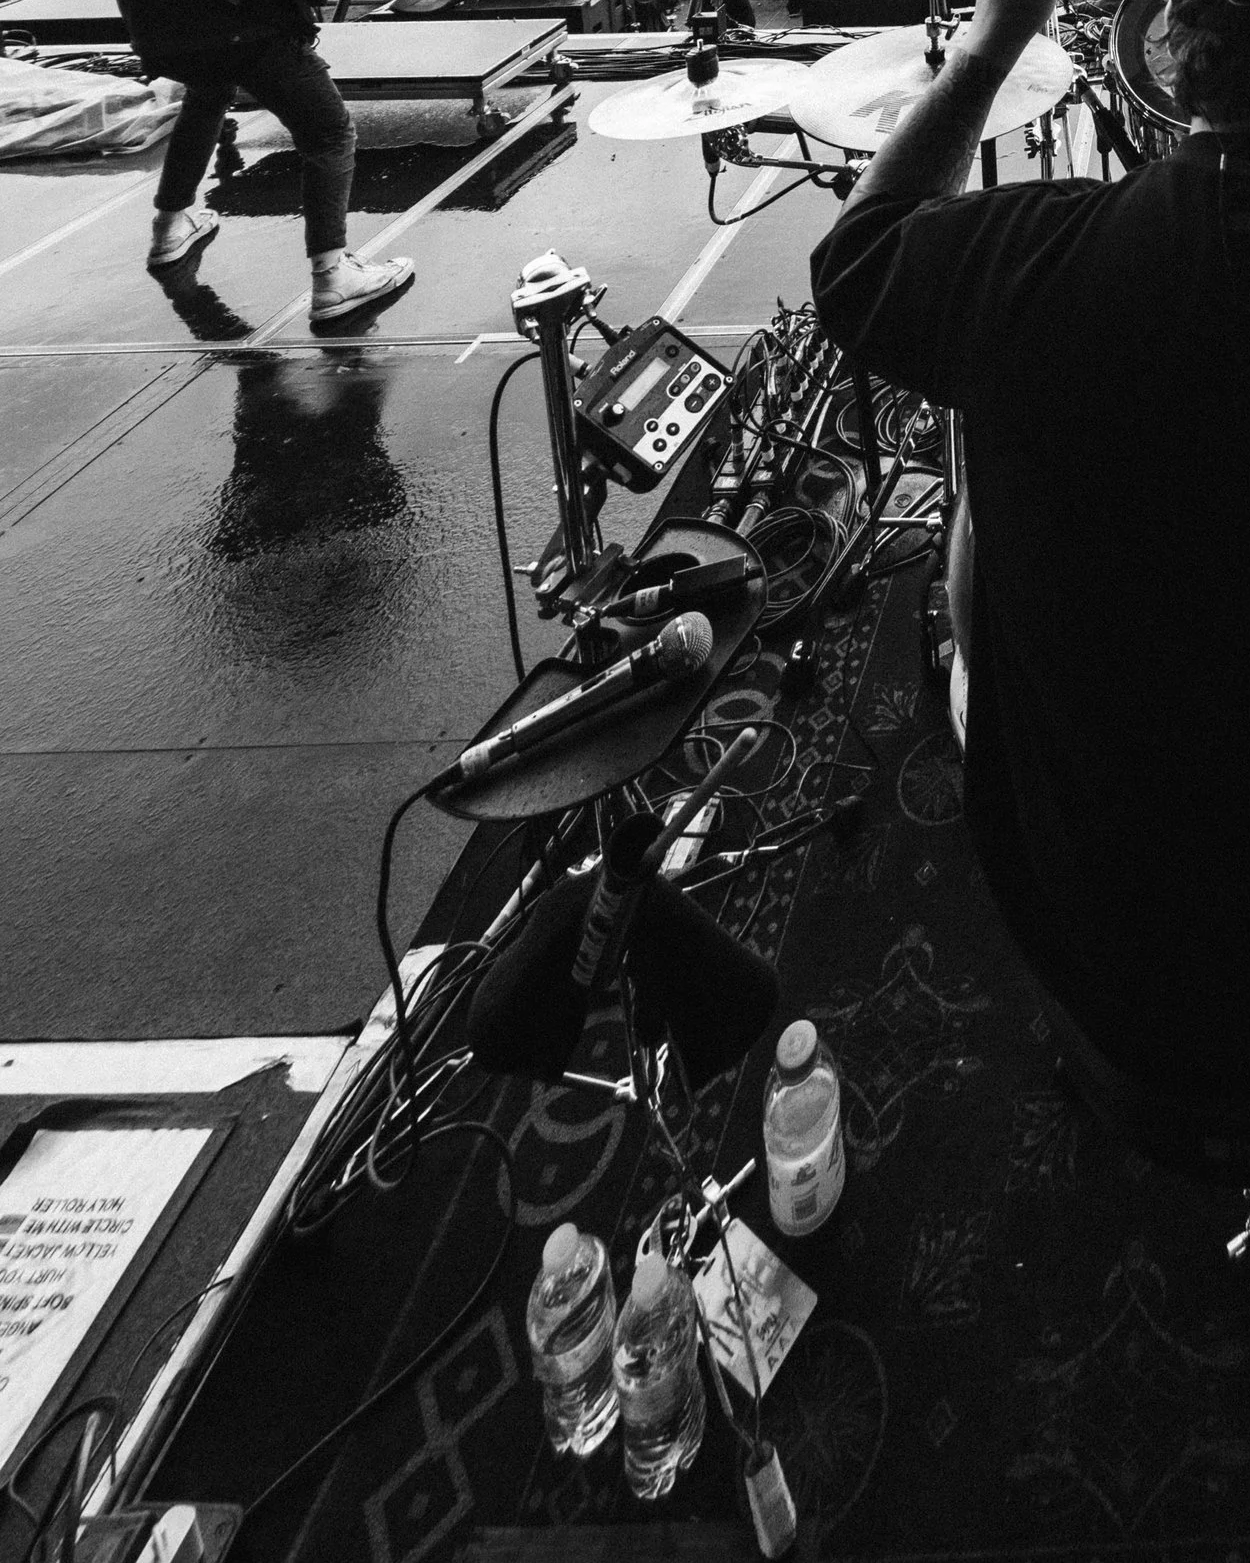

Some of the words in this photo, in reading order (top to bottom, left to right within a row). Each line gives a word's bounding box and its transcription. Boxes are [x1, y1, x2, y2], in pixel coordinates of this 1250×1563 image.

[610, 350, 636, 375] Roland
[31, 1198, 88, 1213] ROLLER
[86, 1196, 126, 1213] HOLY
[81, 1218, 134, 1234] CIRCLE
[4, 1243, 62, 1259] JACKET
[60, 1242, 118, 1259] YELLOW
[26, 1268, 67, 1285] HURT
[0, 1294, 34, 1312] SPIN
